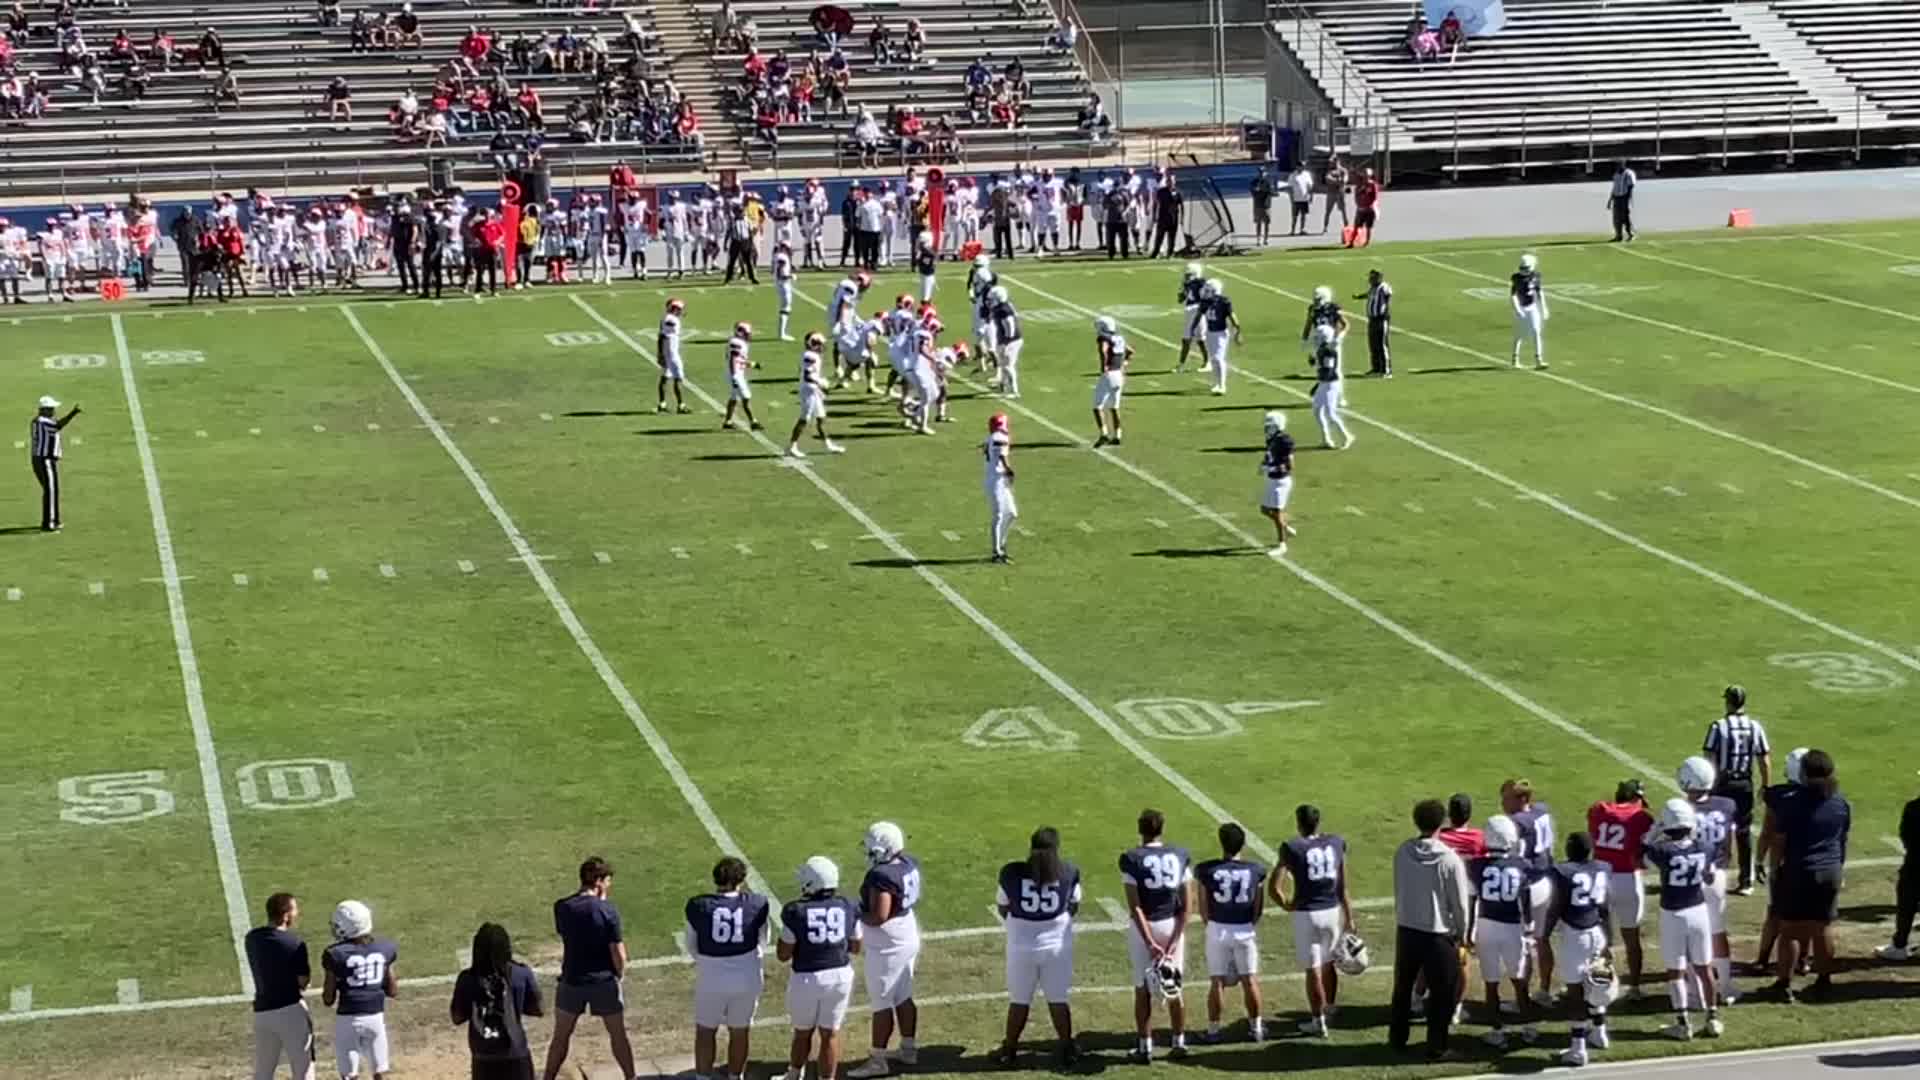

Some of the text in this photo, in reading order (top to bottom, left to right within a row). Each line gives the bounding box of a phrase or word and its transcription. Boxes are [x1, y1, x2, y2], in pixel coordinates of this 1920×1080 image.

[1596, 821, 1625, 850] 12
[1143, 852, 1181, 889] 39
[1213, 869, 1252, 903] 37
[1482, 866, 1520, 902] 20
[1669, 853, 1706, 887] 27
[1020, 879, 1060, 913] 55
[1571, 871, 1607, 905] 24
[711, 906, 744, 943] 61
[806, 906, 846, 944] 59
[345, 952, 386, 987] 30
